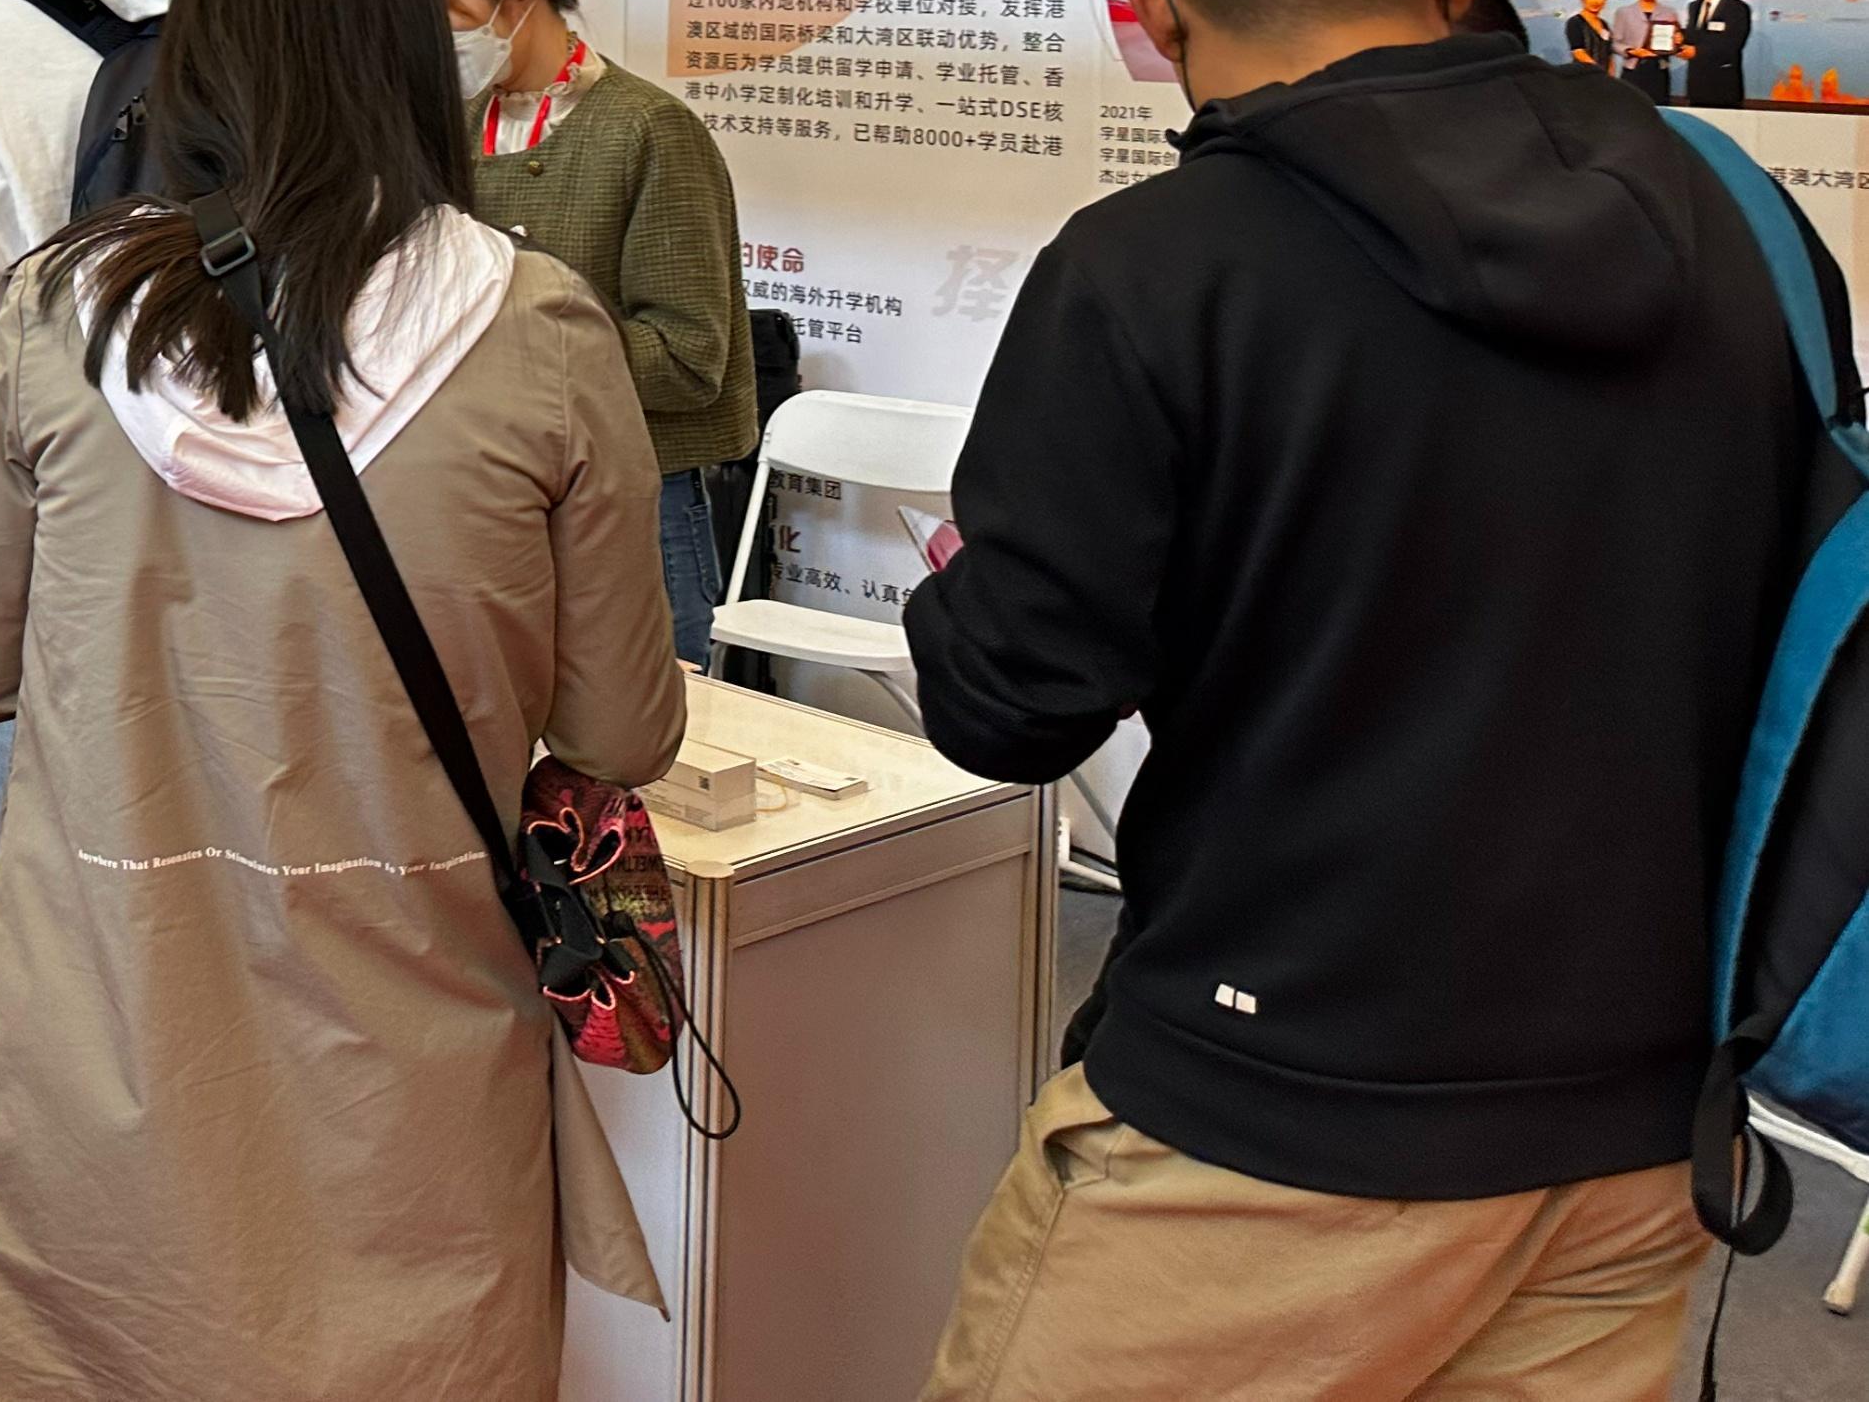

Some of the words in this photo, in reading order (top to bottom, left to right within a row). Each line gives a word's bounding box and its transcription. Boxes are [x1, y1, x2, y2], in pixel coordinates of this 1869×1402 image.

[1100, 105, 1152, 120] 2021年
[702, 112, 1063, 157] 技术支持等服务，已帮助8000+学员赴港
[1099, 127, 1167, 144] 宇星国际
[1099, 170, 1151, 185] 杰出女
[121, 859, 149, 870] That
[205, 846, 222, 858] Or
[282, 865, 310, 876] Your
